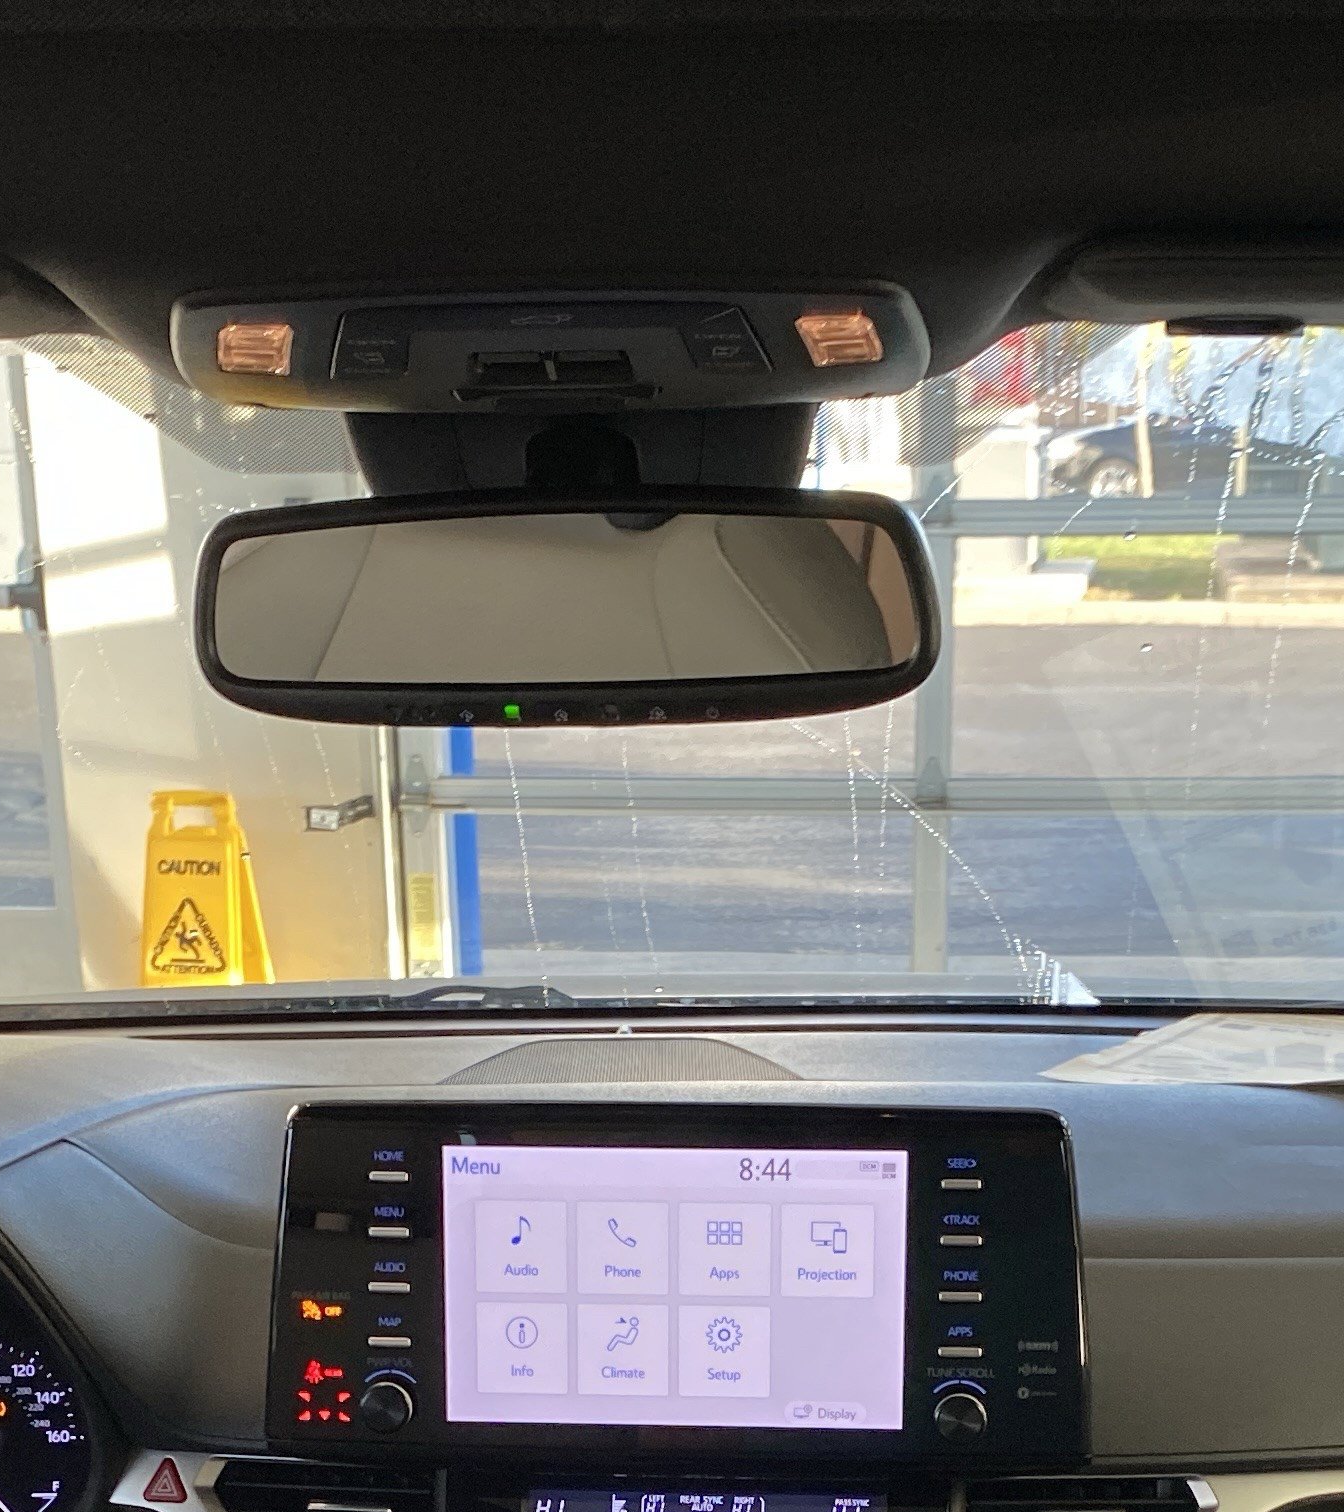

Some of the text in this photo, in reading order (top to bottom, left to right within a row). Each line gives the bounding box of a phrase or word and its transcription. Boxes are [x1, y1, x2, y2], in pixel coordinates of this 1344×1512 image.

[157, 859, 222, 876] CAUTION
[373, 1151, 404, 1162] HOME
[451, 1157, 501, 1175] Menu
[739, 1157, 792, 1181] 8:44
[862, 1162, 877, 1170] DCM
[374, 1207, 405, 1217] MENU
[374, 1263, 406, 1273] AUDIO
[504, 1264, 539, 1276] Audio
[605, 1265, 642, 1278] Phone
[710, 1267, 740, 1281] Apps
[797, 1268, 857, 1283] Projection
[943, 1271, 979, 1282] PHONE
[378, 1317, 402, 1327] MAP
[947, 1326, 973, 1337] APPS
[11, 1364, 36, 1378] 120
[511, 1364, 534, 1378] Info
[601, 1366, 646, 1380] Climate
[707, 1368, 741, 1383] Setup
[34, 1391, 61, 1405] 140
[817, 1407, 857, 1422] Display
[46, 1430, 71, 1443] 160
[52, 1481, 61, 1491] F
[680, 1495, 724, 1505] REAR SYNC
[691, 1503, 714, 1512] AUTO
